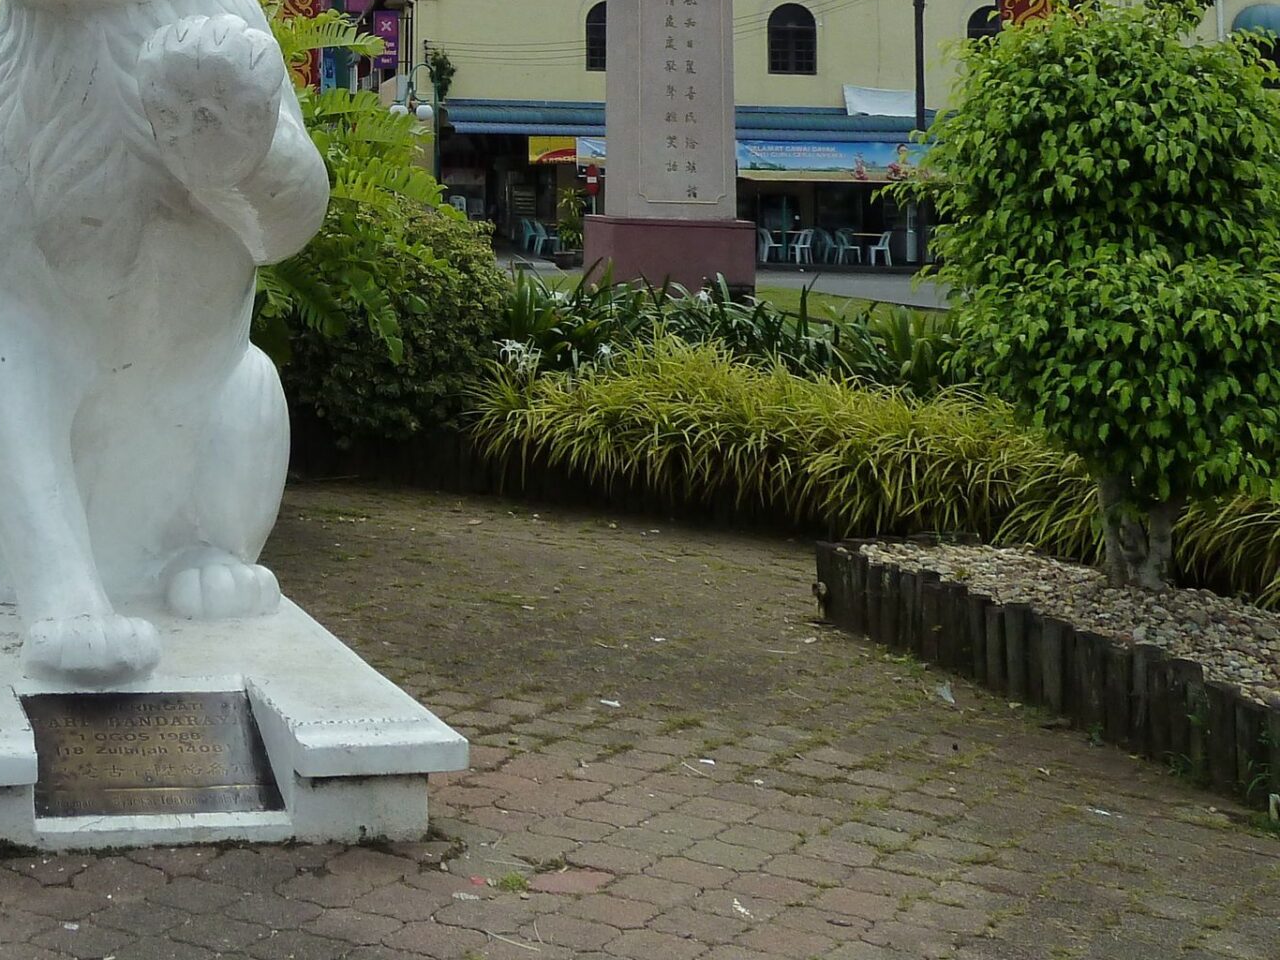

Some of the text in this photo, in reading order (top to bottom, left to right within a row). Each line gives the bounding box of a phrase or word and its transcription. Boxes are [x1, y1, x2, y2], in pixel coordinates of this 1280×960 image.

[79, 732, 202, 743] 1 OGOS 1988
